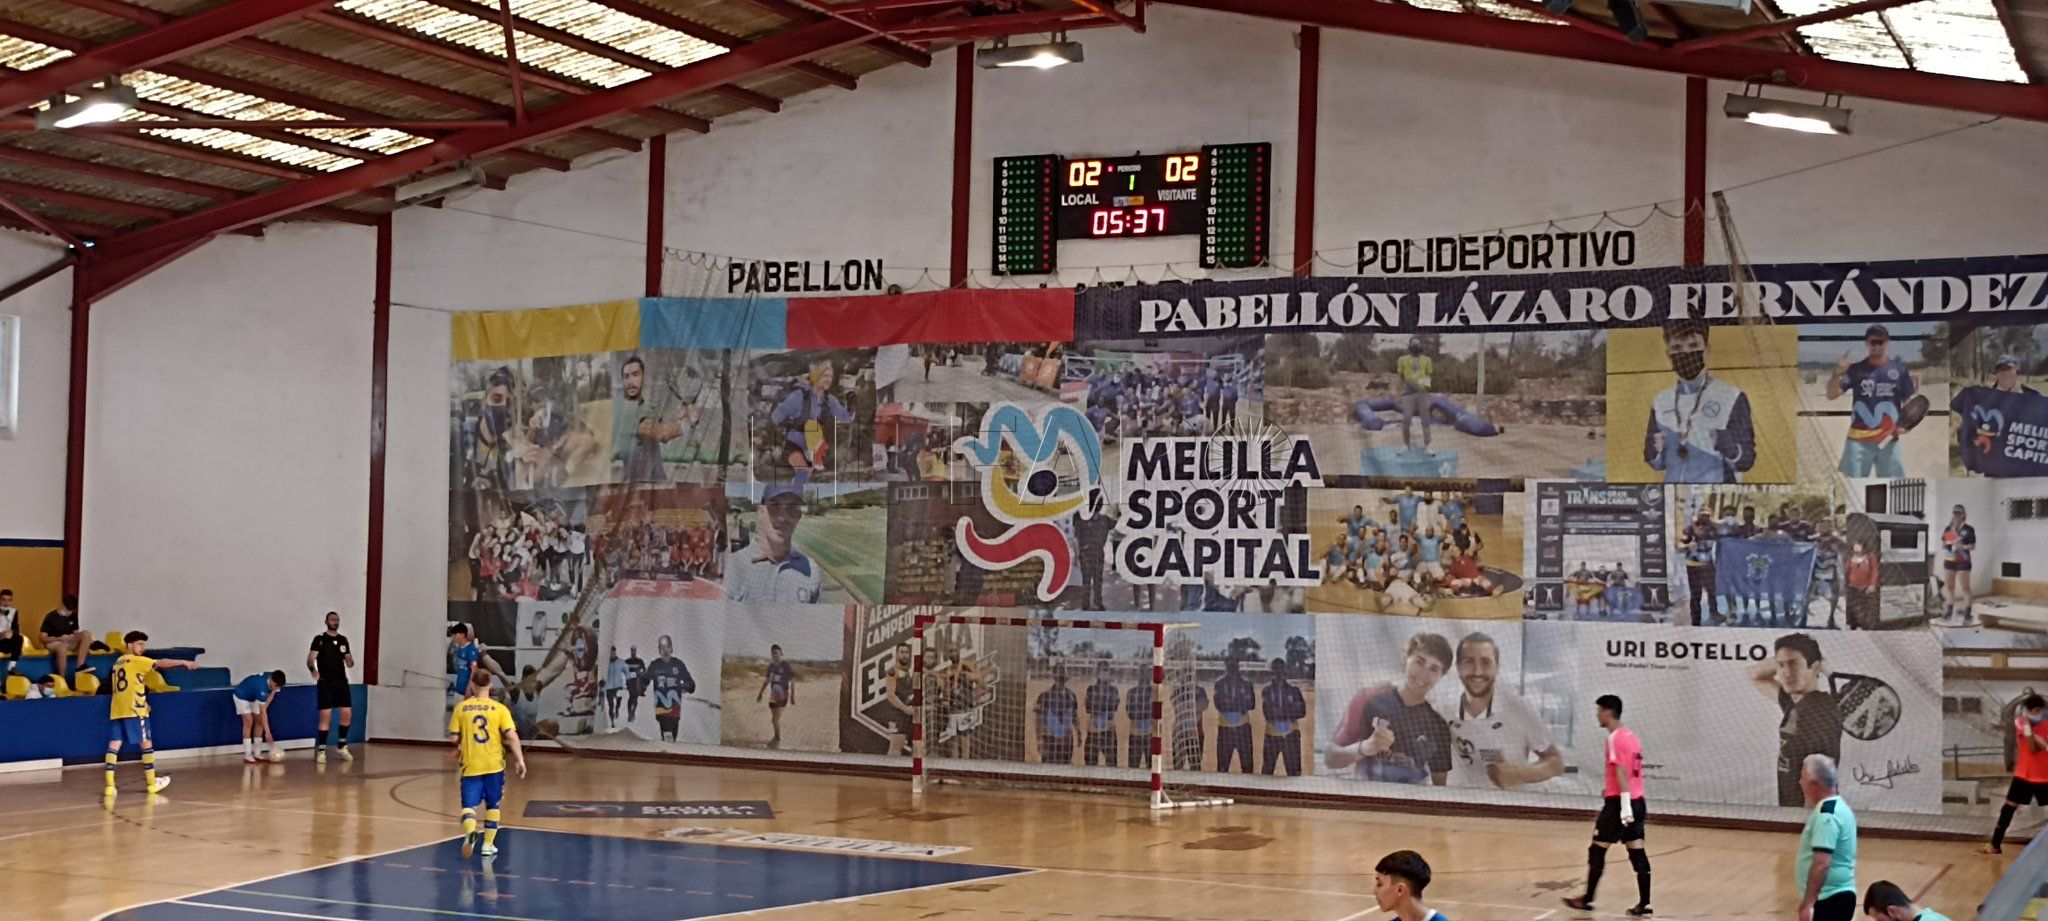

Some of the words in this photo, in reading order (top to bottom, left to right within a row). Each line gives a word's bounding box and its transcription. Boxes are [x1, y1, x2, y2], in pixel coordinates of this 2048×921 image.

[1211, 148, 1217, 156] 4
[1165, 155, 1199, 182] 02
[1211, 158, 1217, 166] 5
[1069, 160, 1102, 187] 02
[1210, 168, 1217, 176] 6
[1129, 174, 1135, 191] 1
[1210, 178, 1217, 186] 7
[1157, 188, 1197, 201] VISITANTE
[1210, 187, 1217, 195] 8
[1061, 193, 1099, 206] LOCAL
[1210, 197, 1217, 205] 9
[1207, 207, 1217, 215] 10
[1092, 208, 1165, 235] 05:37
[1206, 217, 1215, 225] 11
[1206, 226, 1216, 235] 12
[1206, 236, 1216, 245] 13
[1206, 246, 1216, 254] 14
[1357, 230, 1635, 275] POLIDEPORTIVO
[1206, 256, 1216, 264] 15
[728, 258, 883, 294] PABELLON
[1138, 282, 1407, 333] PABELLÓN
[1417, 280, 1653, 328] LÁZARO
[1667, 268, 2048, 321] FERNÁNDEZ
[1127, 439, 1321, 481] MELILLA
[1128, 488, 1284, 530] SPORT
[1124, 536, 1321, 579] CAPITAL
[1606, 639, 1646, 658] URI
[1655, 641, 1768, 662] BOTELLO
[472, 715, 491, 744] 3
